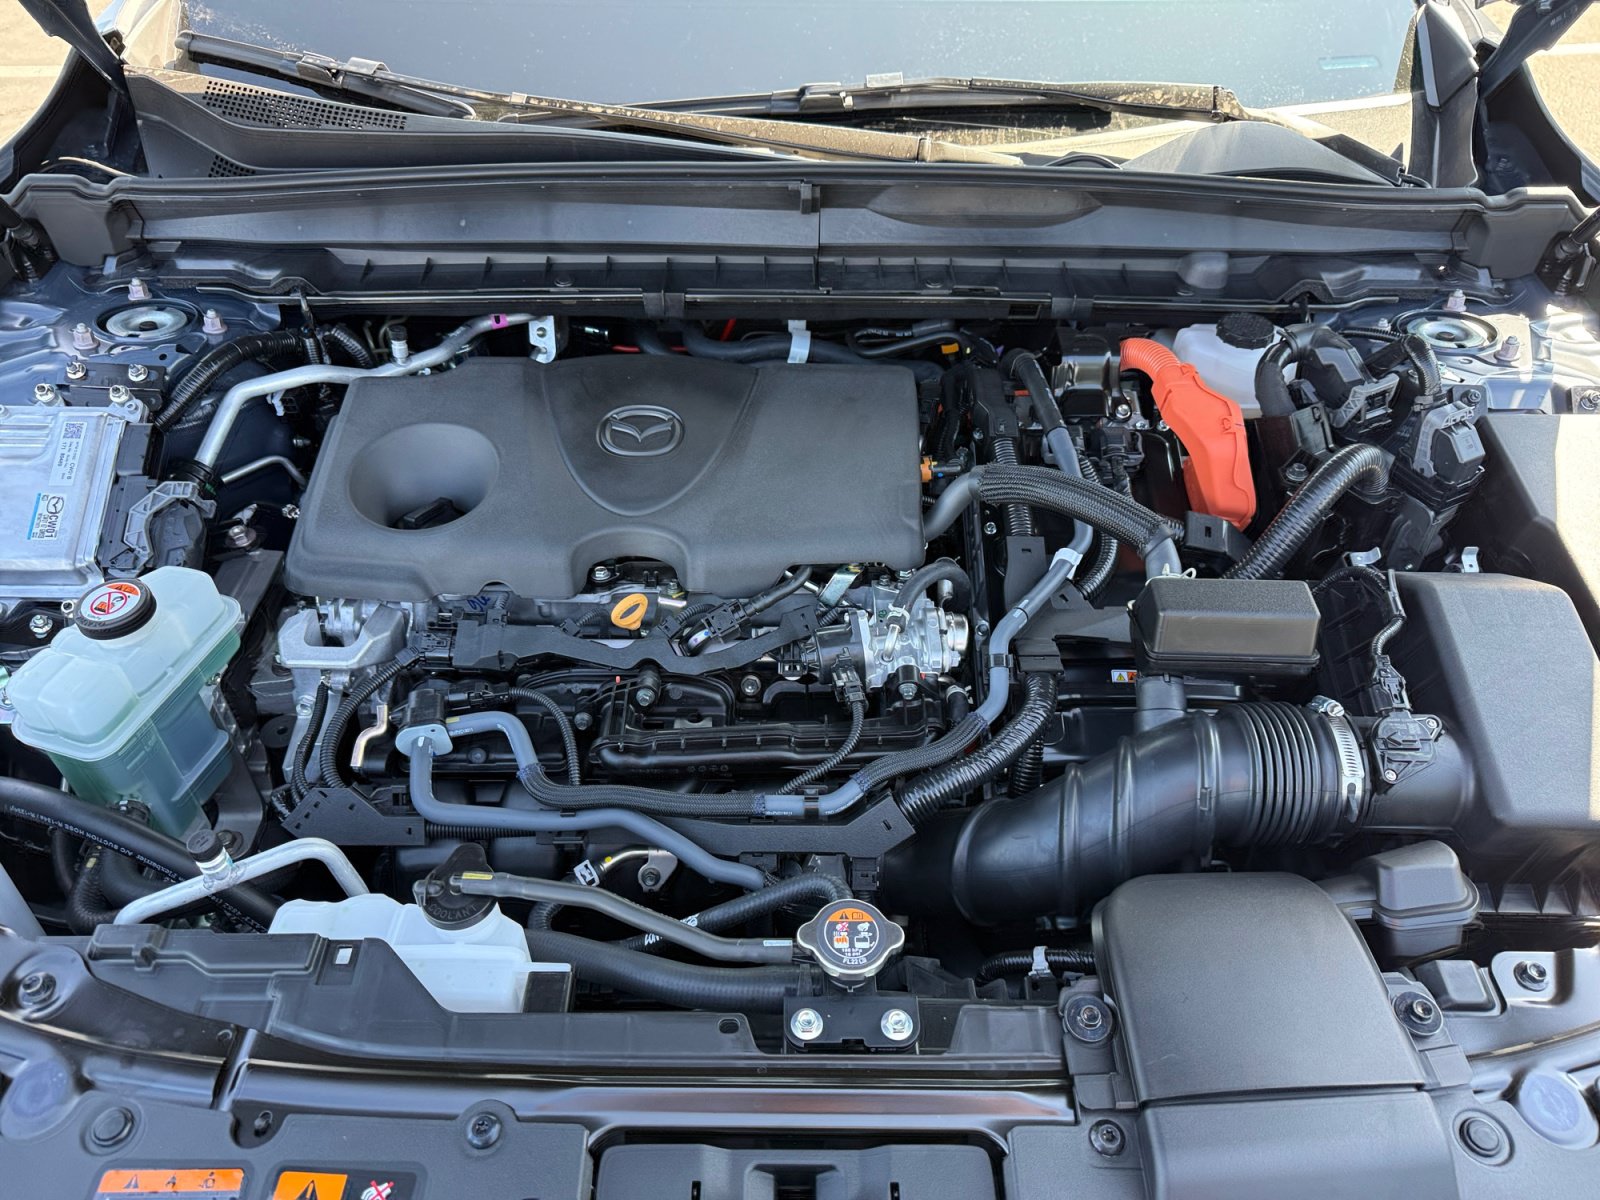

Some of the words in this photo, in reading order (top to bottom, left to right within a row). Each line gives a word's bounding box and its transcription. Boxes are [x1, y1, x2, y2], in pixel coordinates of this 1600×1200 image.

[45, 514, 59, 538] CW01
[63, 822, 85, 836] HOSE
[85, 831, 119, 850] SUCTION
[135, 853, 178, 879] Flexbarrier
[428, 903, 478, 920] COOLANT
